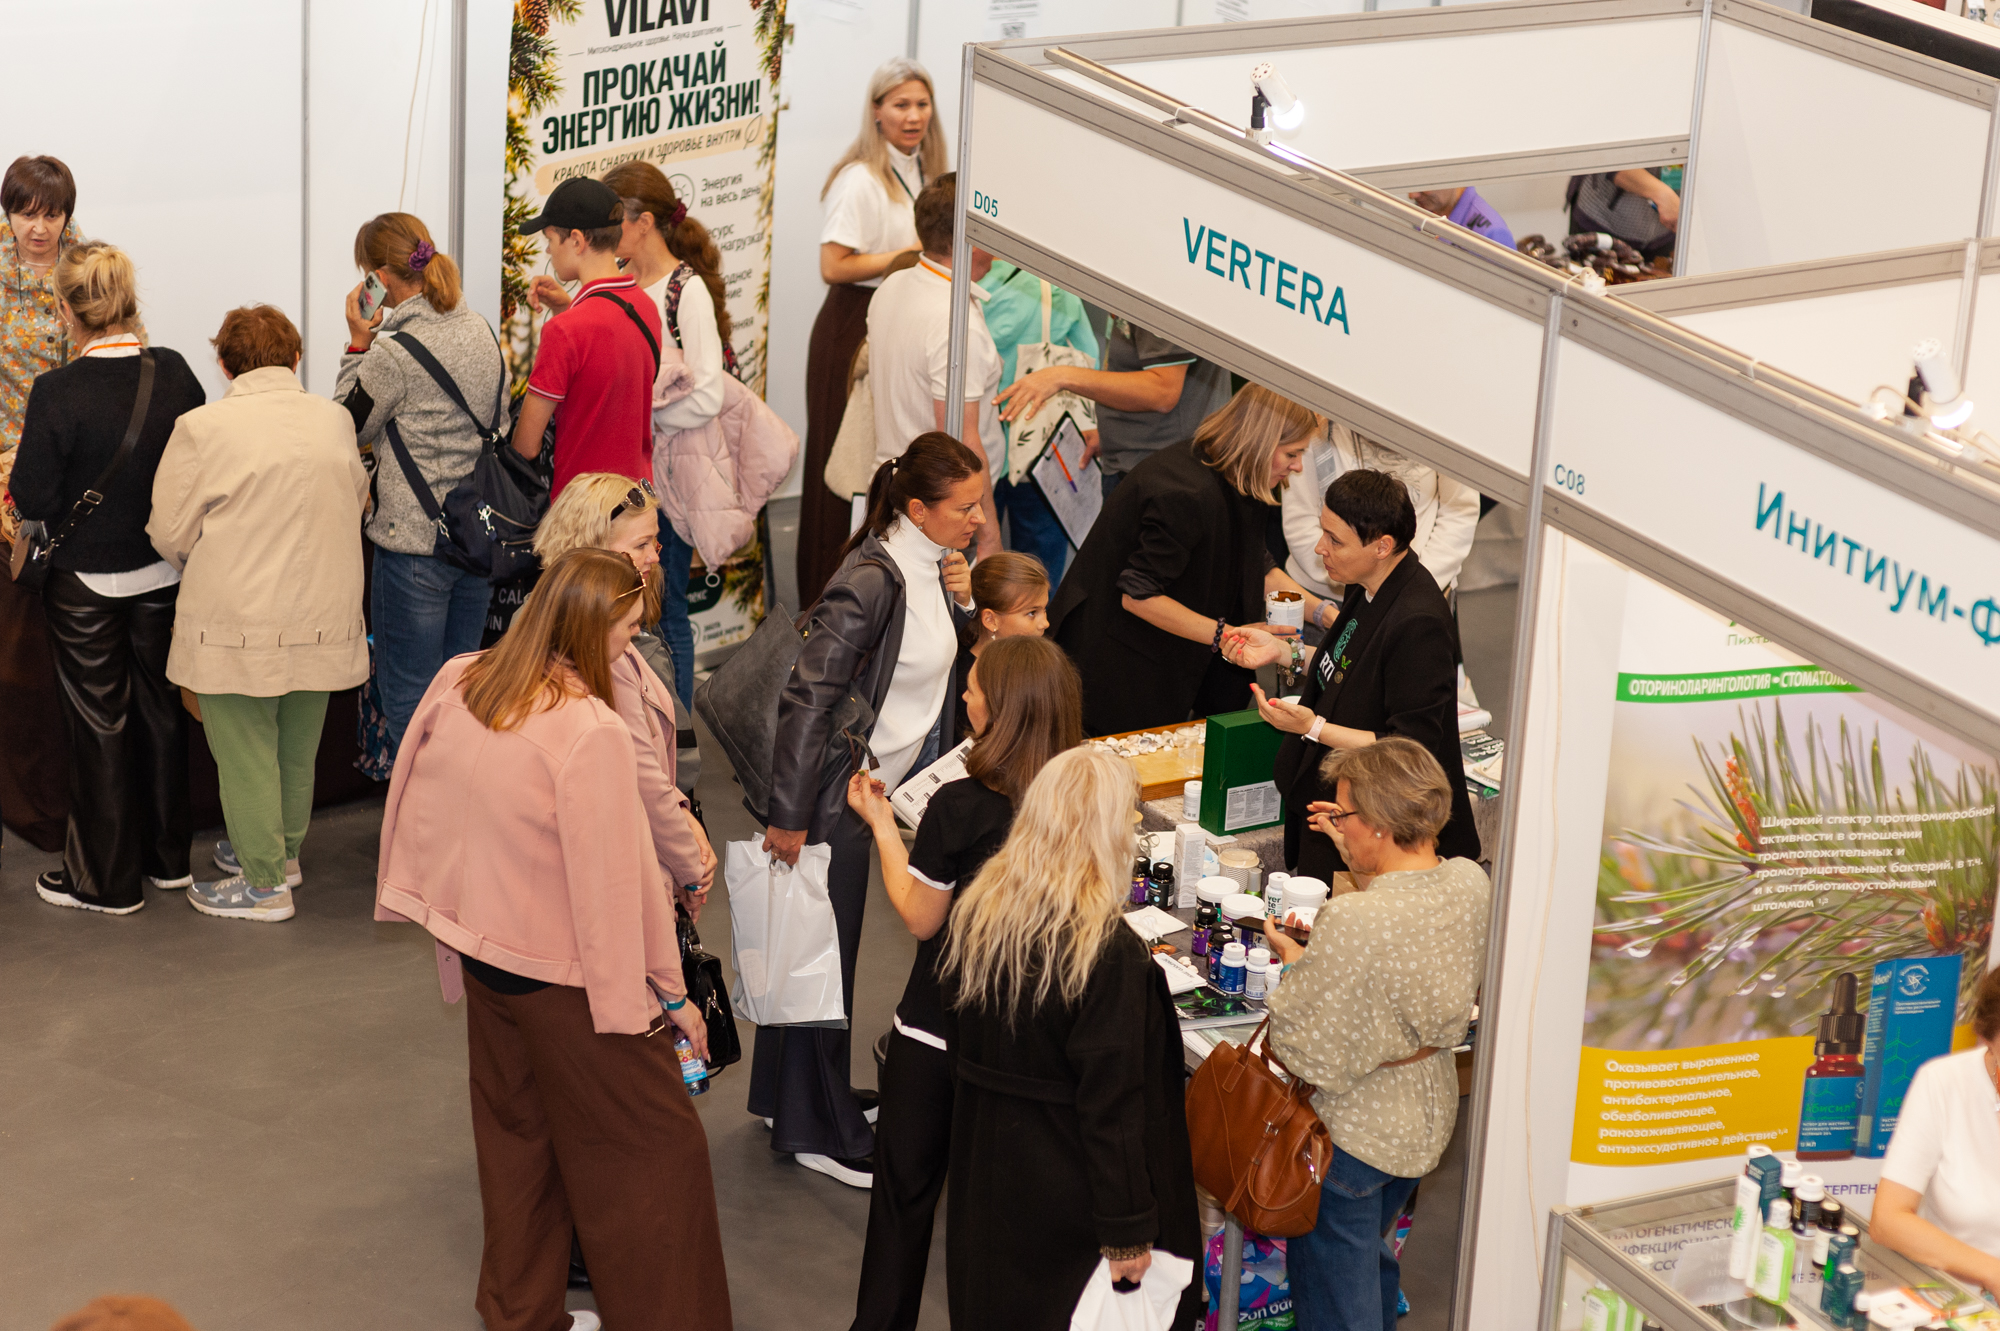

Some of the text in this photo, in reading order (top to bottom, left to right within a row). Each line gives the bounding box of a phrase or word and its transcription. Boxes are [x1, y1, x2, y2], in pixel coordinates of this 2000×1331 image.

[583, 40, 727, 108] ПРОКАЧАЙ
[542, 79, 761, 155] ЭНЕРГИЮ ЖИЗНИ!
[553, 160, 597, 183] КРАСОТА
[646, 146, 655, 159] И
[656, 135, 704, 164] ЗДОРОВЬЕ
[705, 128, 742, 148] ВНУТРИ
[702, 173, 743, 192] Энергия
[700, 184, 761, 208] на весь день
[973, 190, 998, 218] D05
[1183, 216, 1350, 336] VERTERA
[1760, 804, 1997, 829] Широкий спектр противомикробной
[1759, 830, 1923, 845] активности в отношении
[1757, 848, 1906, 863] грамположительных и
[1755, 858, 1984, 880] грамотрицательных бактерий, в т.ч.
[1754, 879, 1937, 895] и к антибиотикоустойчивым
[1752, 899, 1815, 912] штаммам
[1605, 1052, 1760, 1074] Оказывает выраженное
[1603, 1068, 1761, 1091] противовоспалительное,
[1601, 1087, 1733, 1106] антибактериальное,
[1600, 1105, 1717, 1122] обезболивающее,
[1598, 1120, 1726, 1139] ранозаживляющее,
[1597, 1136, 1720, 1155] антиэкссудативное
